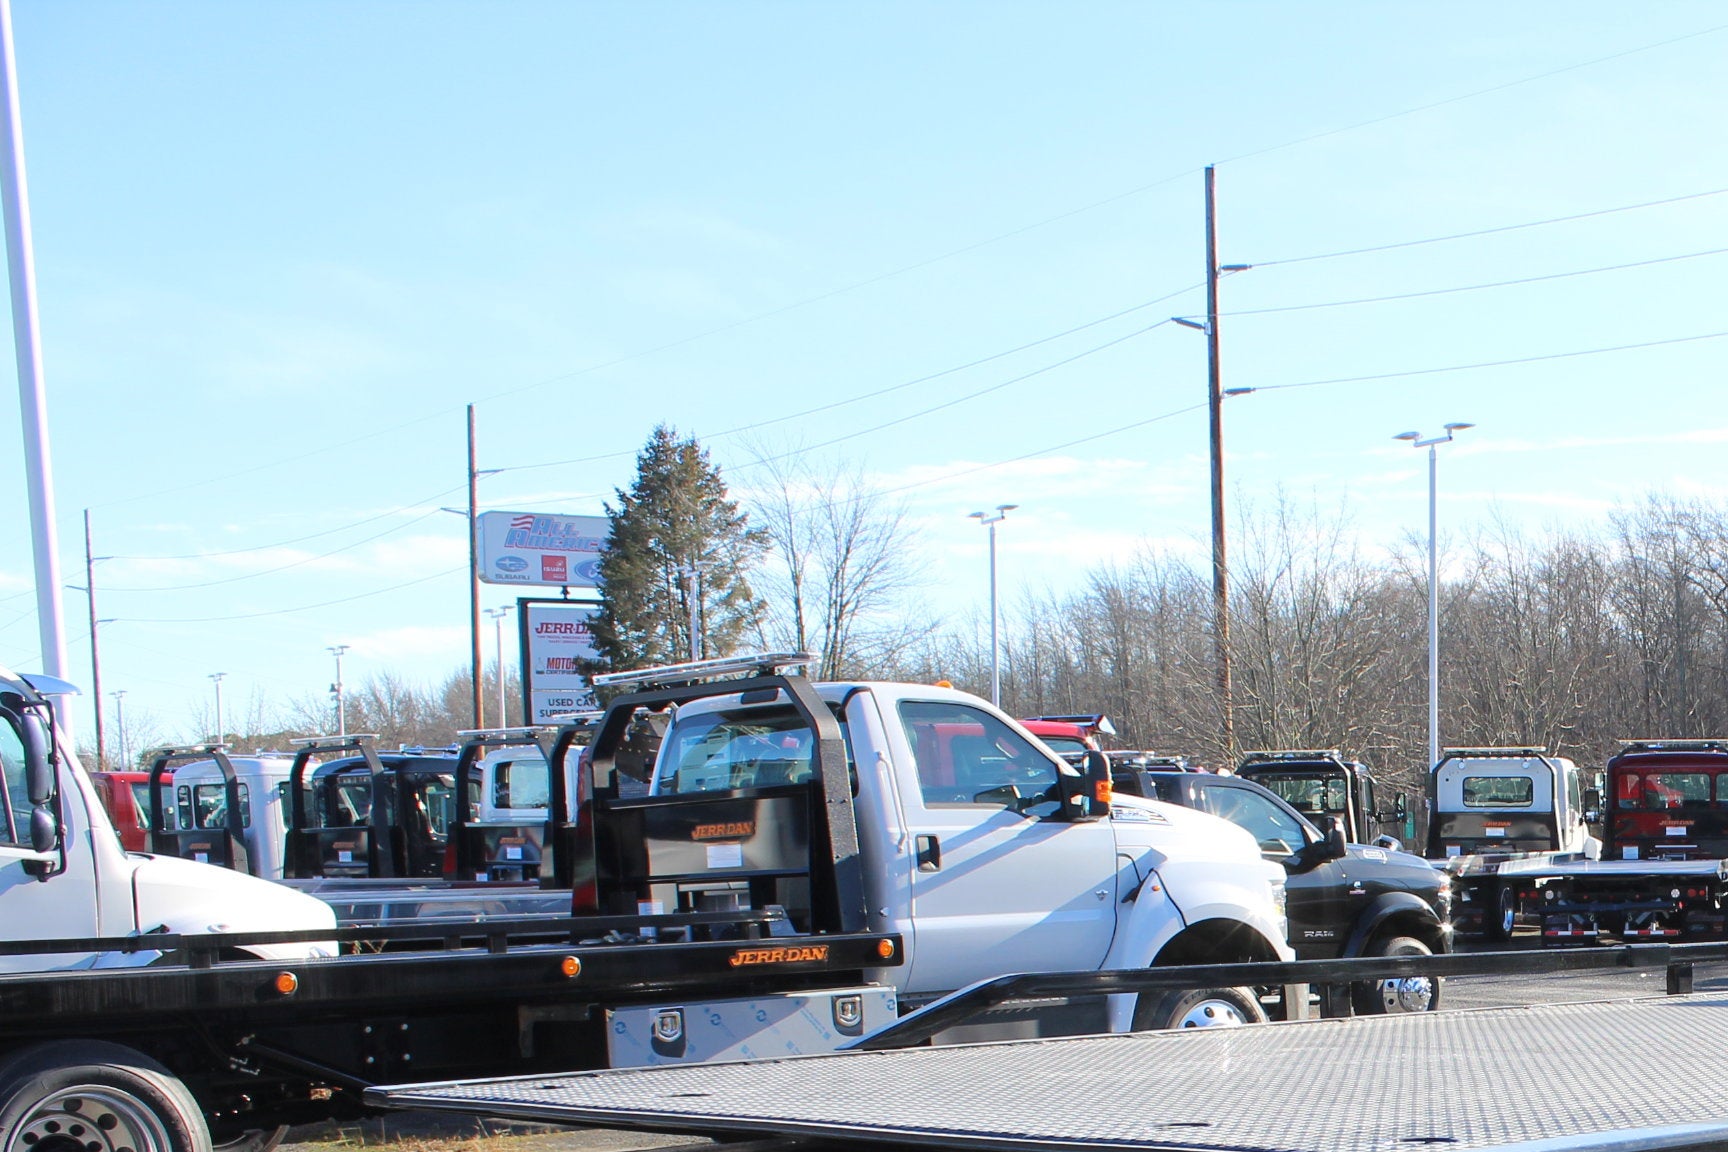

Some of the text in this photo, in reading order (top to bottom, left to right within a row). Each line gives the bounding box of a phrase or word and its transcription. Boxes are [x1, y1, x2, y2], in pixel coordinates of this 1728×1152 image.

[530, 516, 580, 536] ALL
[543, 565, 566, 573] ISUZU
[495, 573, 531, 581] SUBARU
[548, 698, 574, 706] USED
